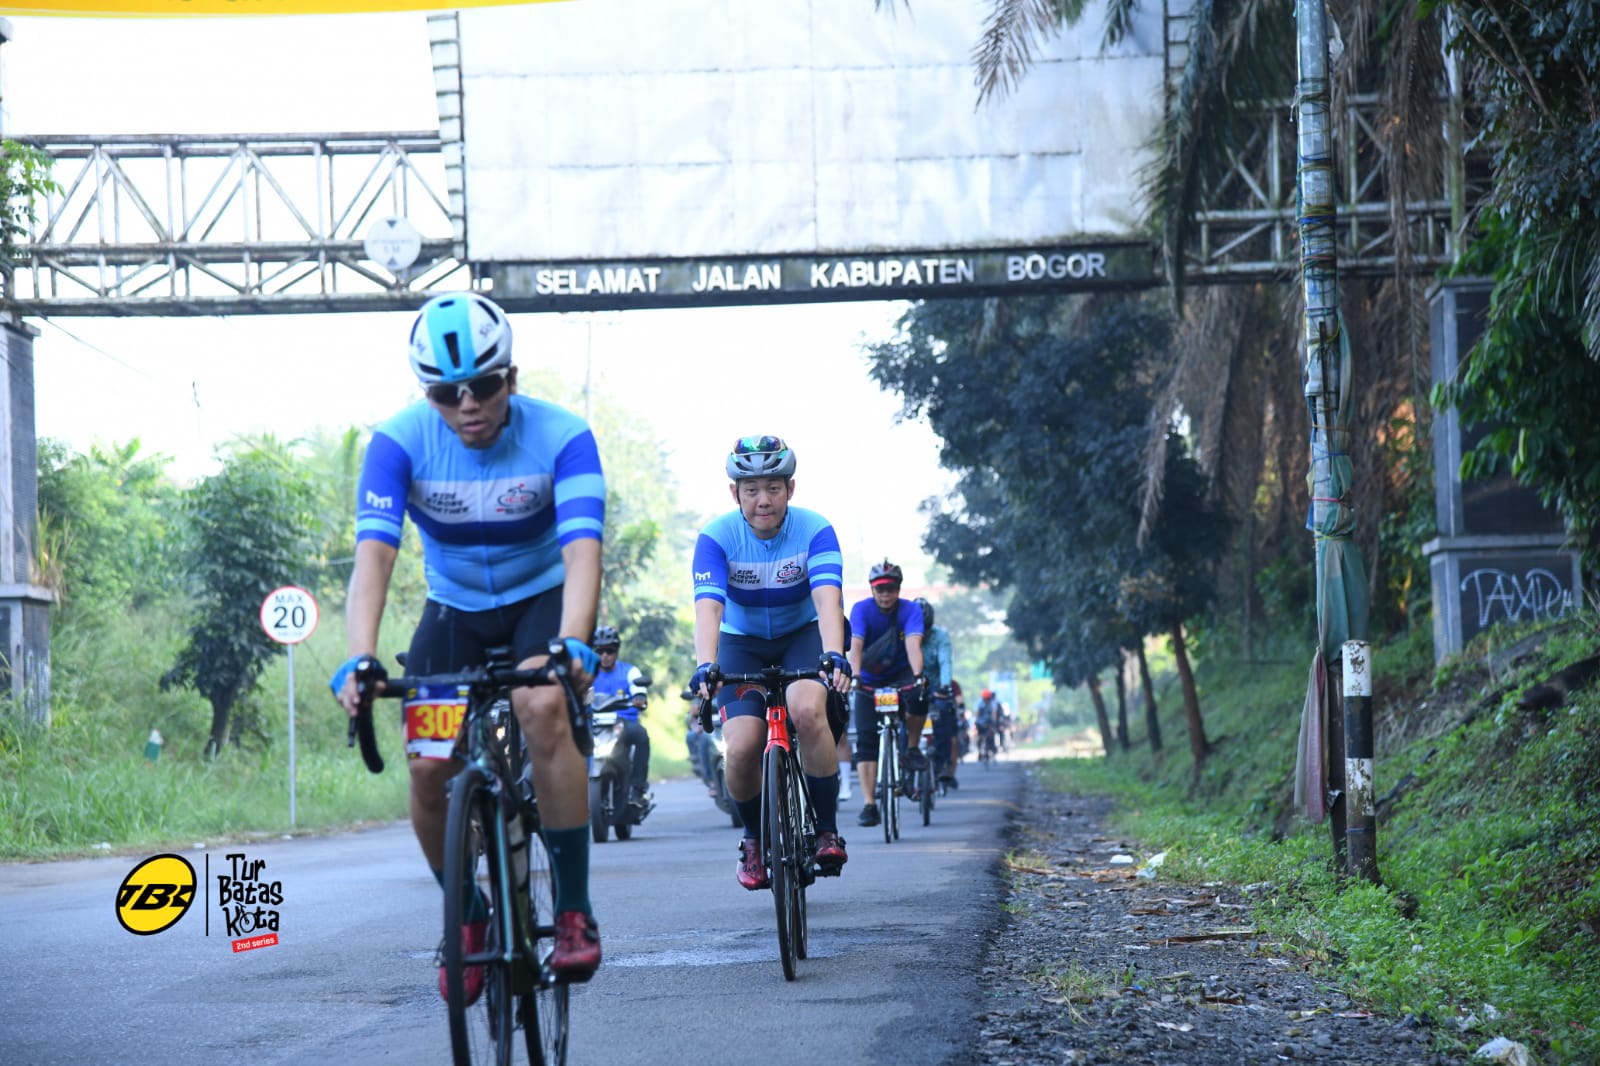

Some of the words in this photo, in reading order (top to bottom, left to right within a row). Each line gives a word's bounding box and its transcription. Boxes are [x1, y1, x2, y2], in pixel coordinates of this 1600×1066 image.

[536, 267, 661, 295] SELAMAT
[692, 264, 781, 291] JALAN
[810, 258, 974, 288] KABUPATEN
[1007, 253, 1106, 281] BOGOR
[275, 594, 304, 604] MAX
[274, 606, 306, 629] 20
